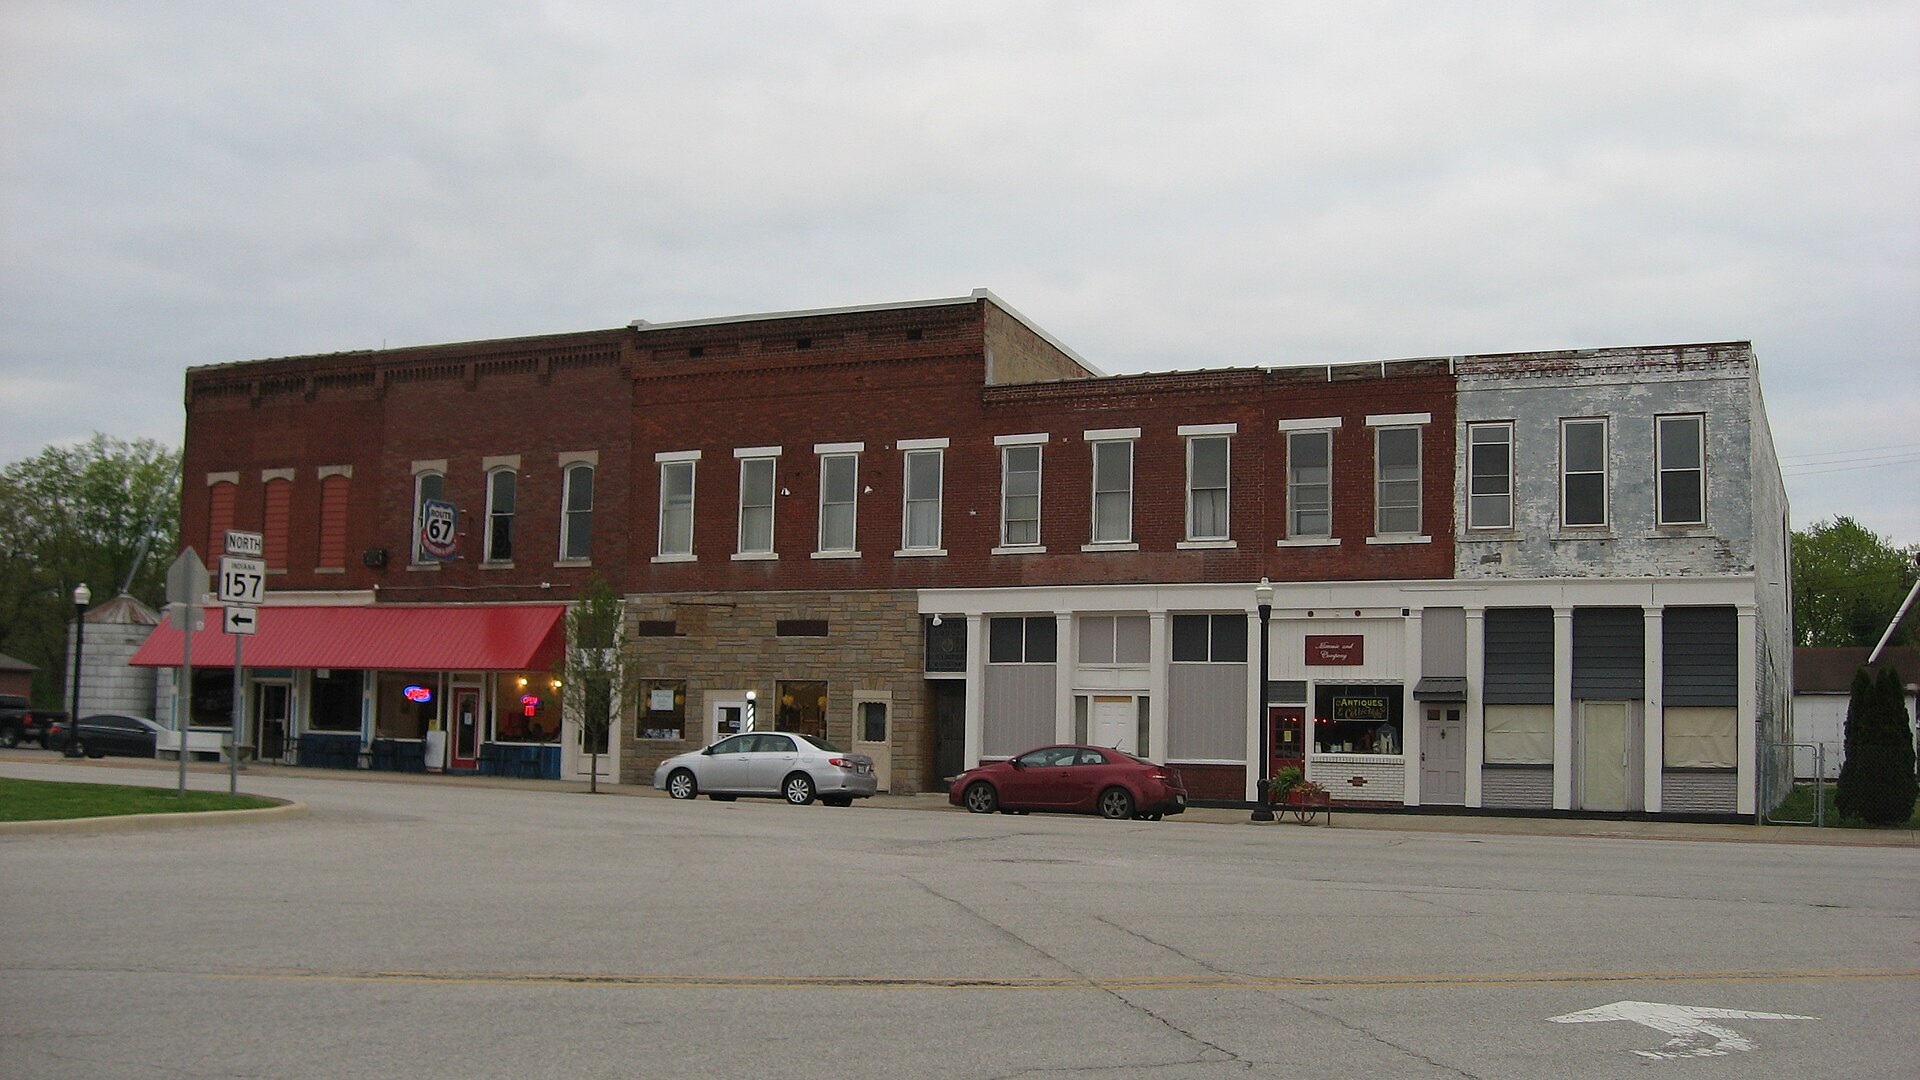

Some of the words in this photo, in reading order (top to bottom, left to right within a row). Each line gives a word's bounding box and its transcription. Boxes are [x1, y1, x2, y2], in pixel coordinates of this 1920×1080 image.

[431, 509, 452, 519] ROUTE
[429, 519, 452, 540] 67
[229, 534, 261, 550] NORTH
[231, 562, 256, 571] INDIANA
[225, 572, 261, 599] 157
[1320, 650, 1347, 661] Company
